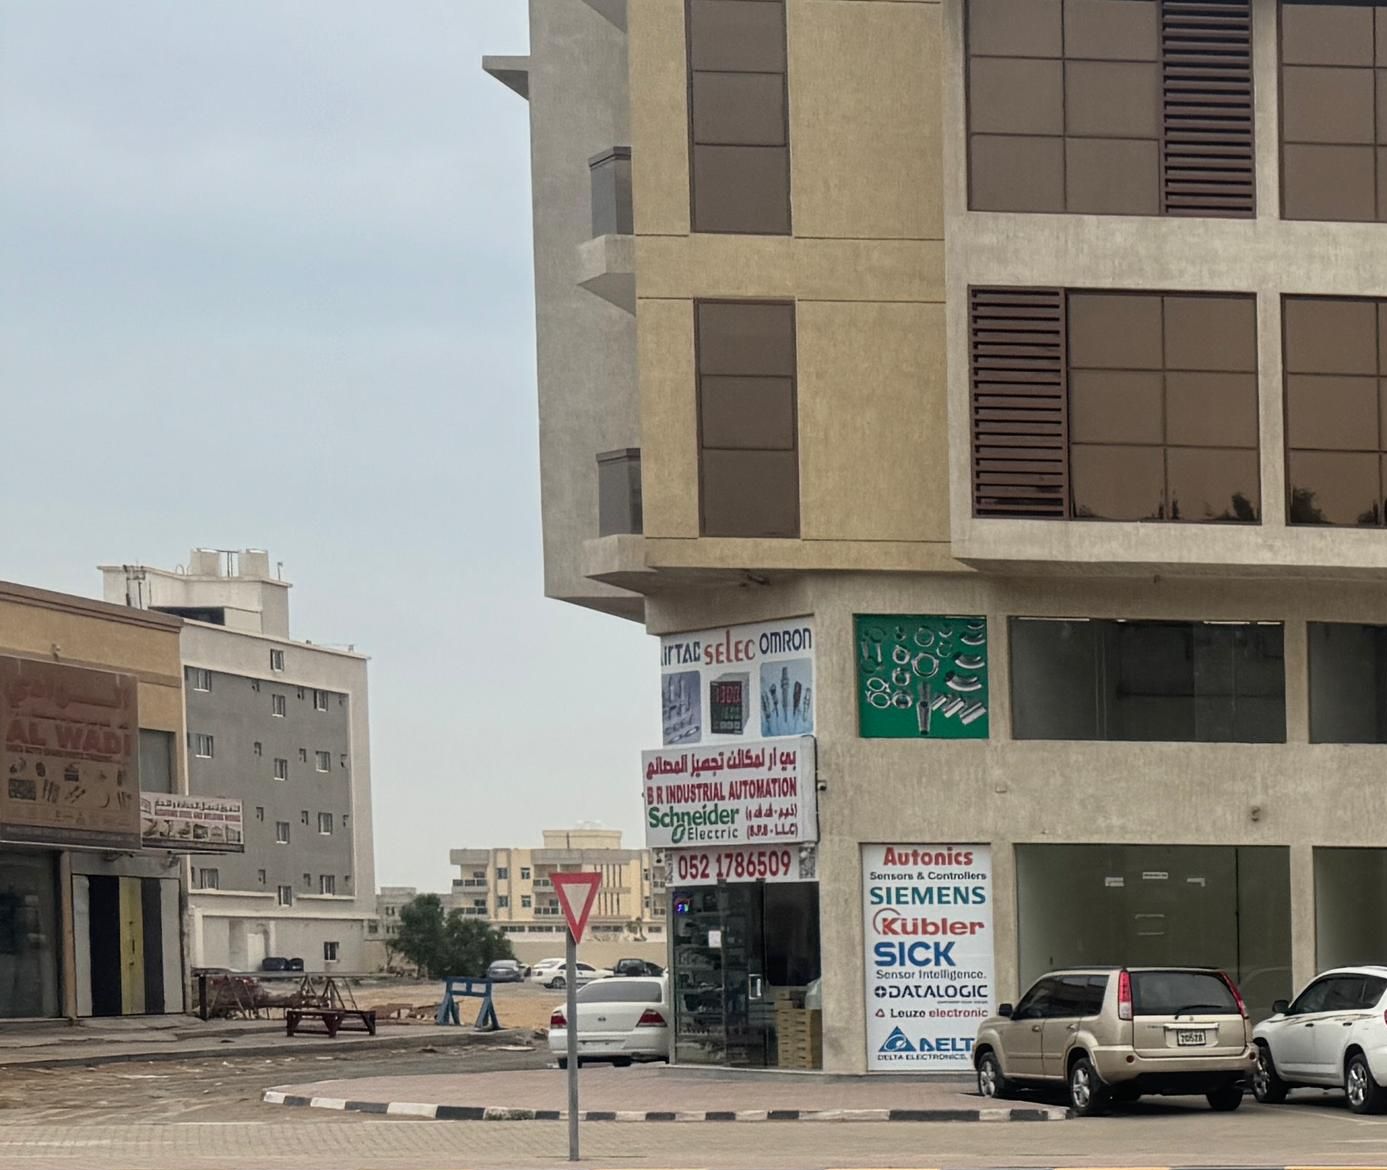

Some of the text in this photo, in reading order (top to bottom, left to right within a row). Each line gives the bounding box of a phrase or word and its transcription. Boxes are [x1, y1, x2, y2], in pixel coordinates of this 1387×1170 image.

[647, 776, 797, 805] B R INDUSTRIAL AUTOMATION
[648, 803, 740, 829] Schneider
[687, 826, 739, 841] Electric
[678, 850, 792, 880] 052 1786509
[883, 847, 974, 866] Autonics
[870, 871, 913, 880] Sensors
[927, 871, 987, 880] Controllers
[870, 886, 986, 905] SIEMENS
[881, 917, 985, 935] Kübler
[874, 941, 956, 967] SICK
[876, 969, 915, 980] Sensor
[888, 985, 988, 998] DATALOGIC
[929, 1008, 988, 1018] electronic
